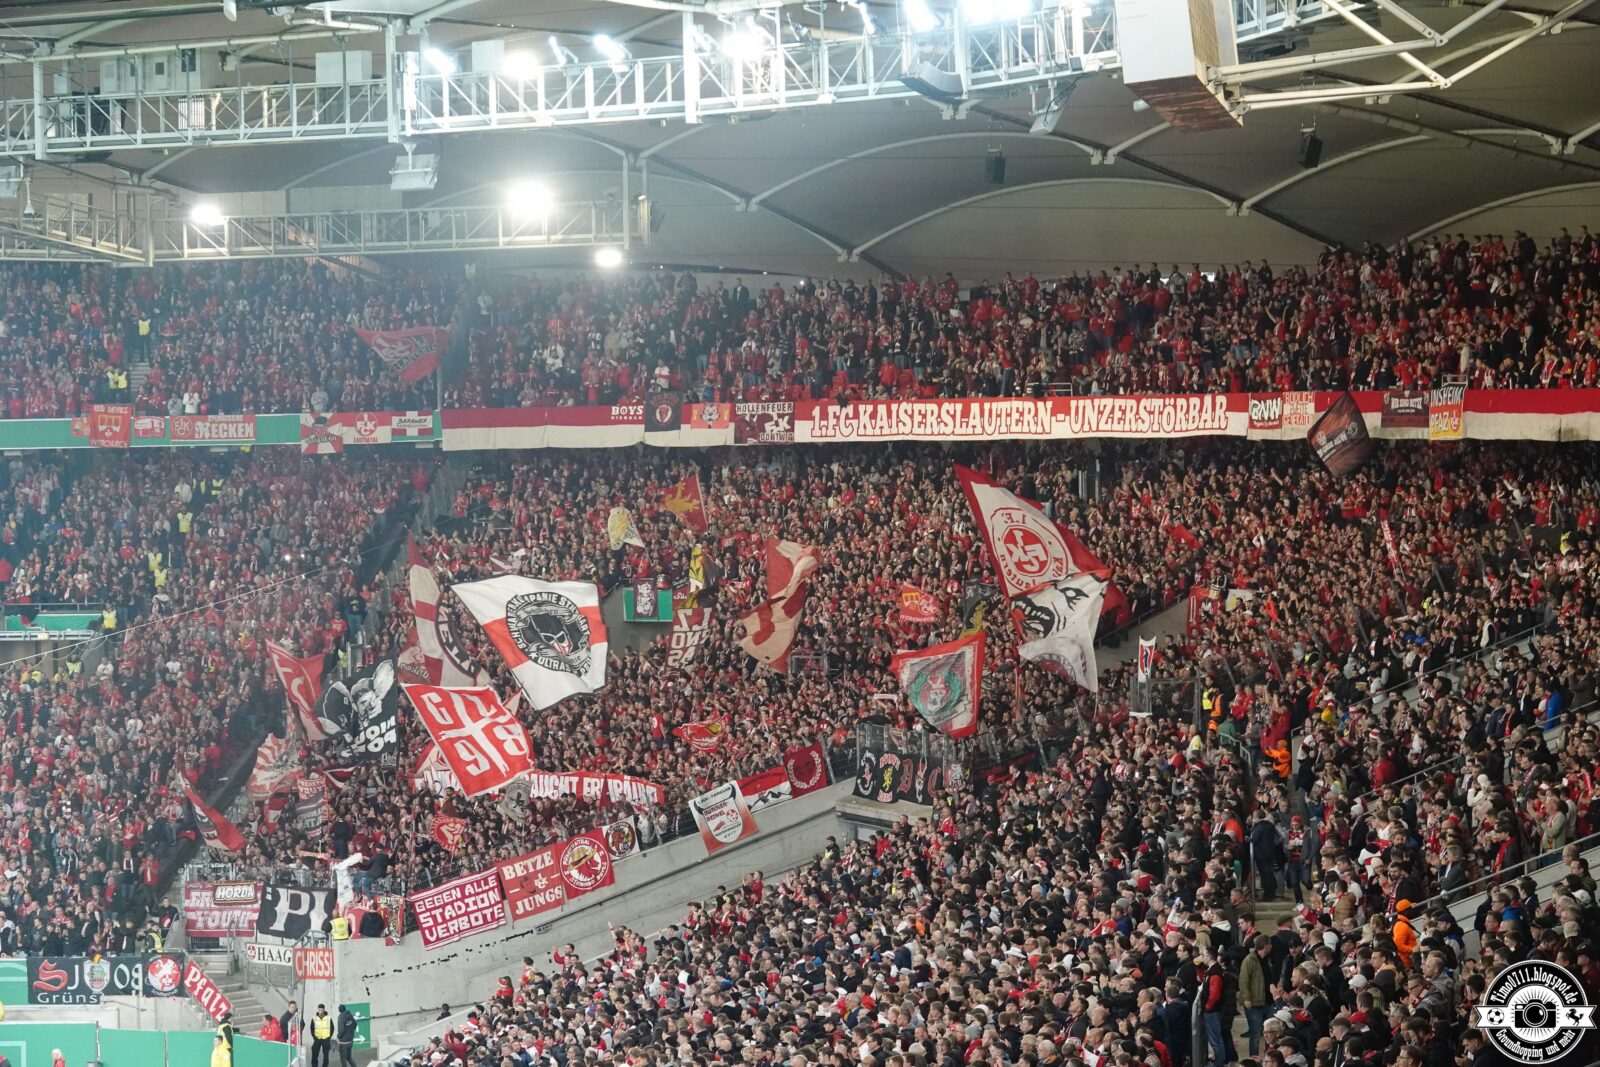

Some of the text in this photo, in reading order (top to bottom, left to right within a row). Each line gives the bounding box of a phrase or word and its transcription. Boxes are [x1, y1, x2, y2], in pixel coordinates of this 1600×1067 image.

[611, 405, 644, 416] BOYS
[811, 404, 853, 437] 1.FC
[502, 851, 554, 881] BETZE
[415, 877, 498, 913] GEGEN ALLE
[418, 888, 501, 928] STADION
[515, 885, 564, 916] JUNGS
[196, 910, 250, 929] YOUTH
[425, 904, 505, 942] VERBOTE
[257, 947, 292, 963] HAAG
